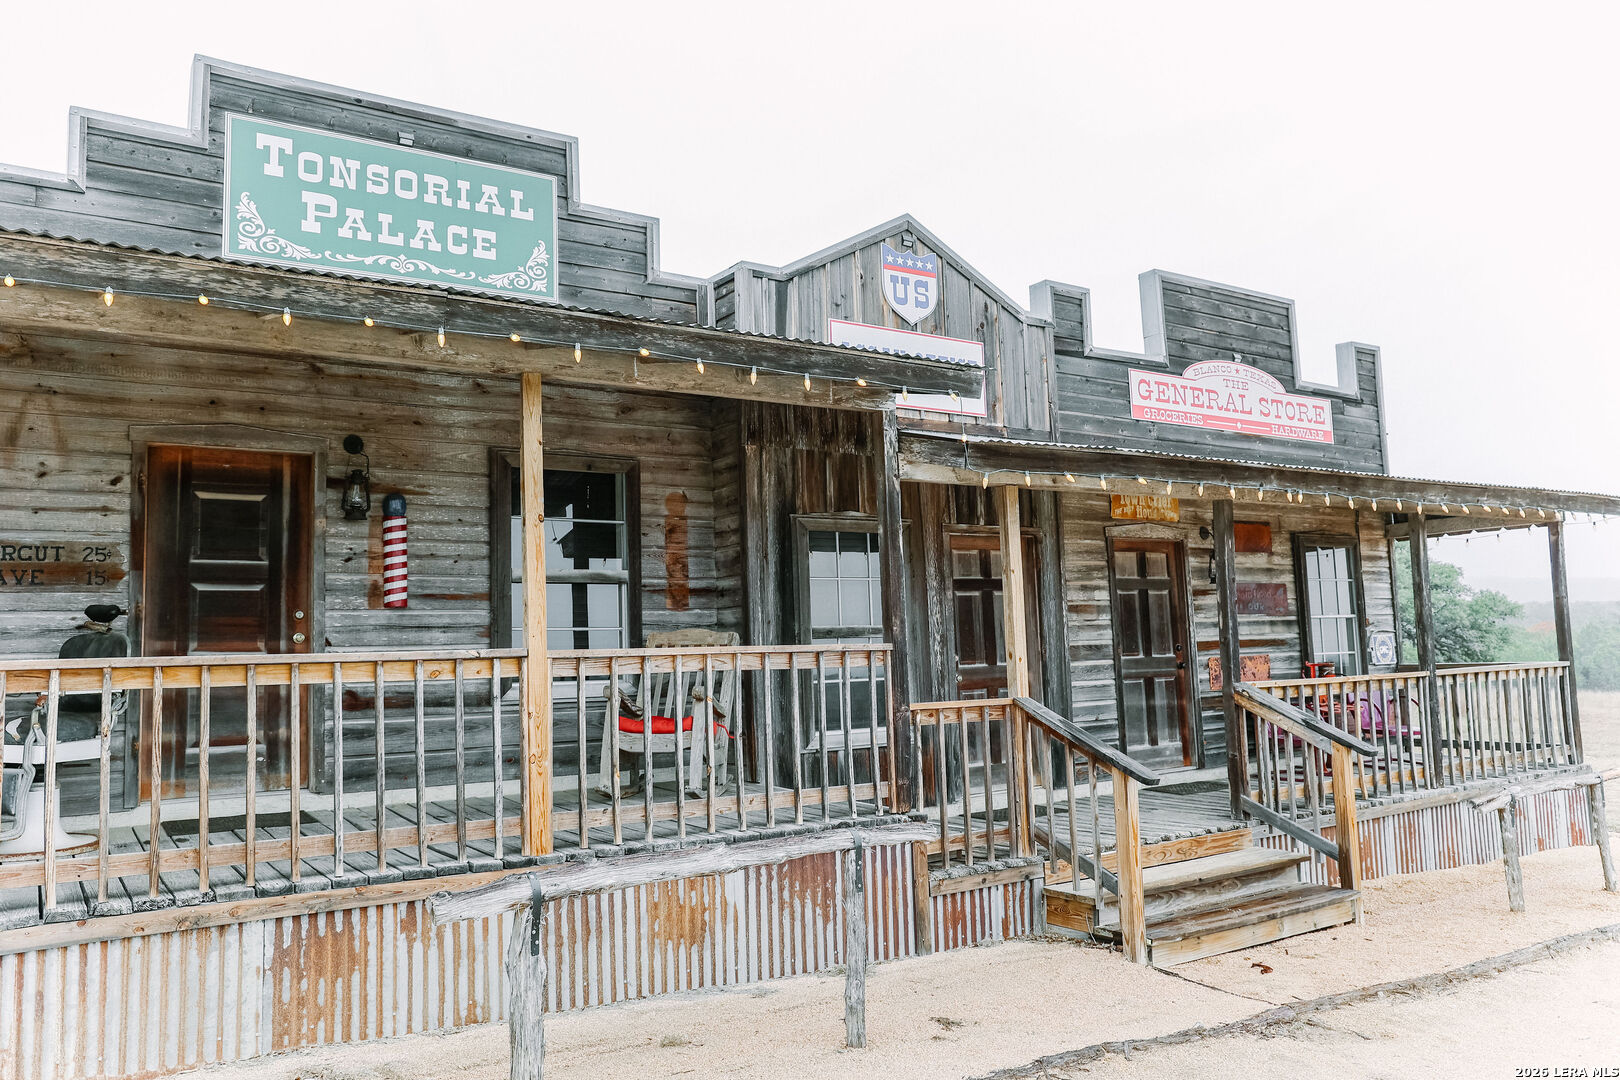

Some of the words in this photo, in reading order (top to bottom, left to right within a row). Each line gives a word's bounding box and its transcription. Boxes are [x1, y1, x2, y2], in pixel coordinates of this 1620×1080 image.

[256, 132, 534, 221] TONSORIAL
[301, 190, 497, 261] PALACE
[889, 274, 930, 309] US
[1193, 365, 1232, 377] BLANCO
[1243, 368, 1277, 390] TEXAS
[1223, 378, 1249, 391] THE
[1137, 378, 1253, 415] GENERAL
[1258, 397, 1326, 425] STORE
[1143, 407, 1204, 425] GROCERIES
[1271, 424, 1325, 441] HARDWARE
[0, 544, 65, 562] RCUT
[0, 569, 45, 586] AVE
